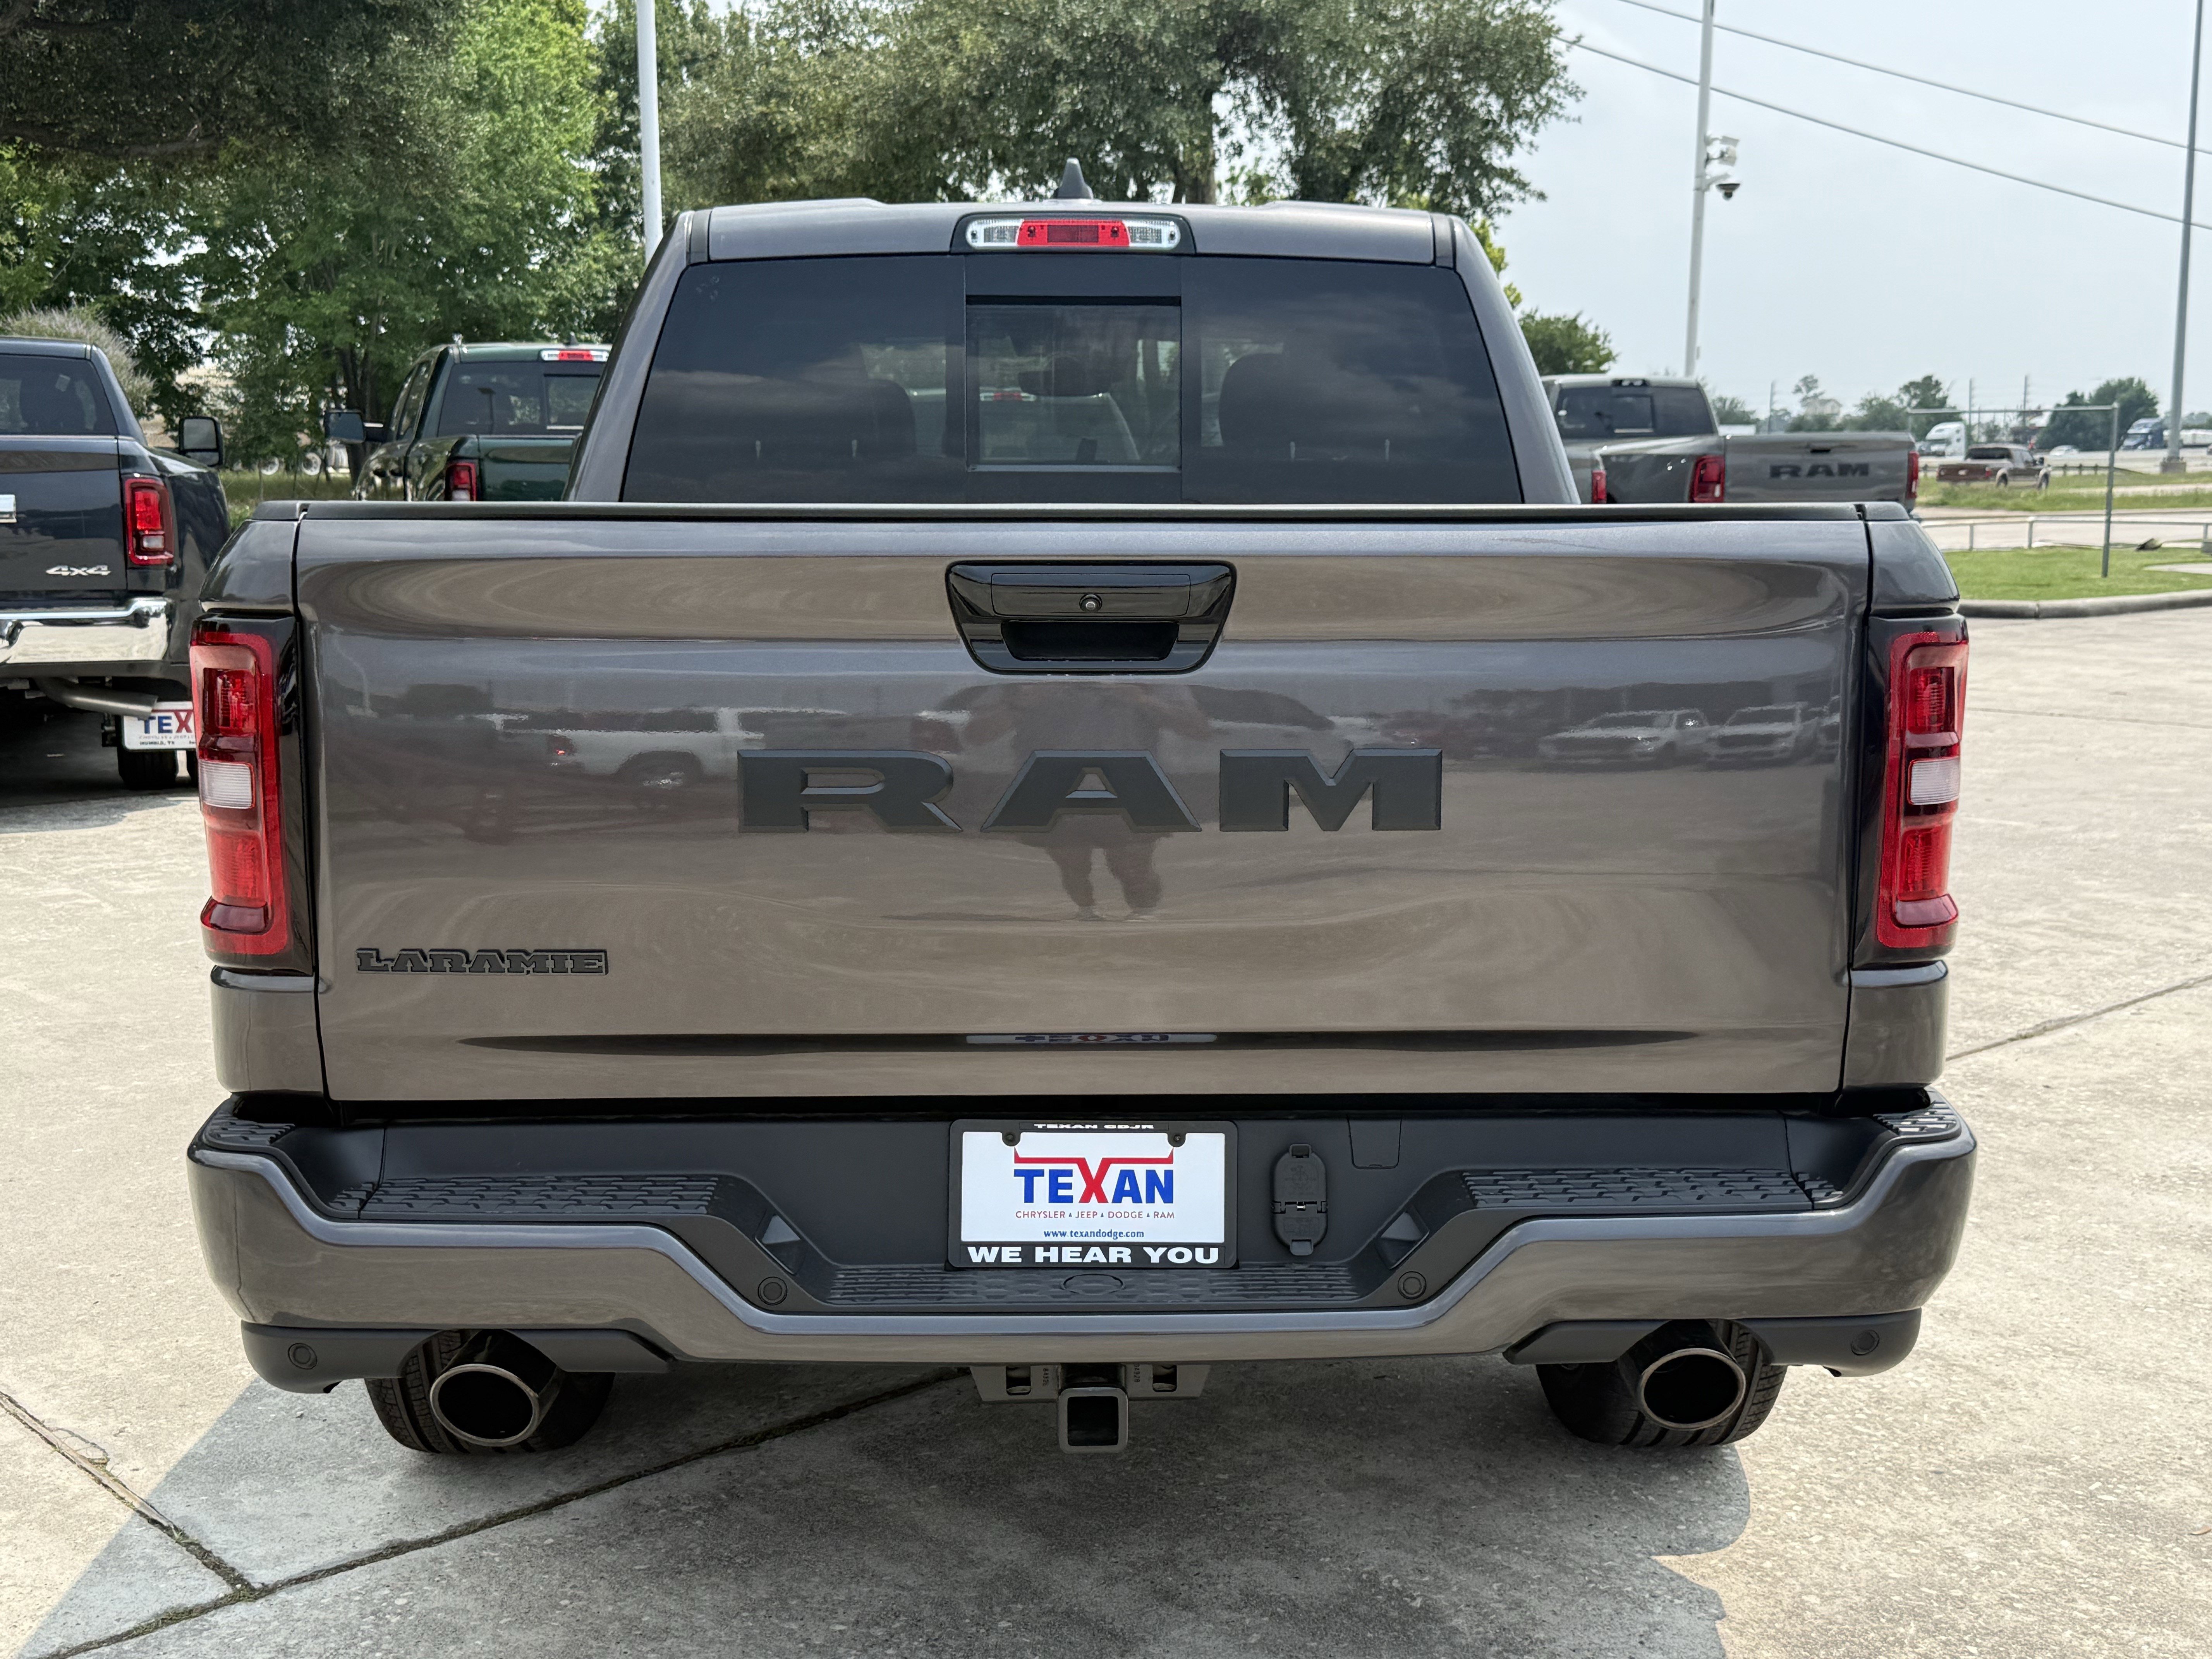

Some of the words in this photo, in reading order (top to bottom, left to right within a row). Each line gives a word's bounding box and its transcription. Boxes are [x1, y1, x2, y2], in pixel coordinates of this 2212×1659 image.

[1769, 463, 1869, 478] RAM
[46, 565, 112, 576] 4x4
[137, 712, 193, 734] TEX
[737, 749, 1442, 832] RAM
[356, 949, 608, 975] LARAMIE
[1013, 1157, 1173, 1204] TEXAN
[1015, 1211, 1066, 1219] CHRYSLER
[1108, 1211, 1143, 1219] DODGE
[1154, 1211, 1175, 1219] RAM
[1044, 1229, 1144, 1239] www.texandodge.com
[967, 1247, 1022, 1262] WE
[1035, 1247, 1132, 1263] HEAR
[1143, 1247, 1219, 1264] YOU
